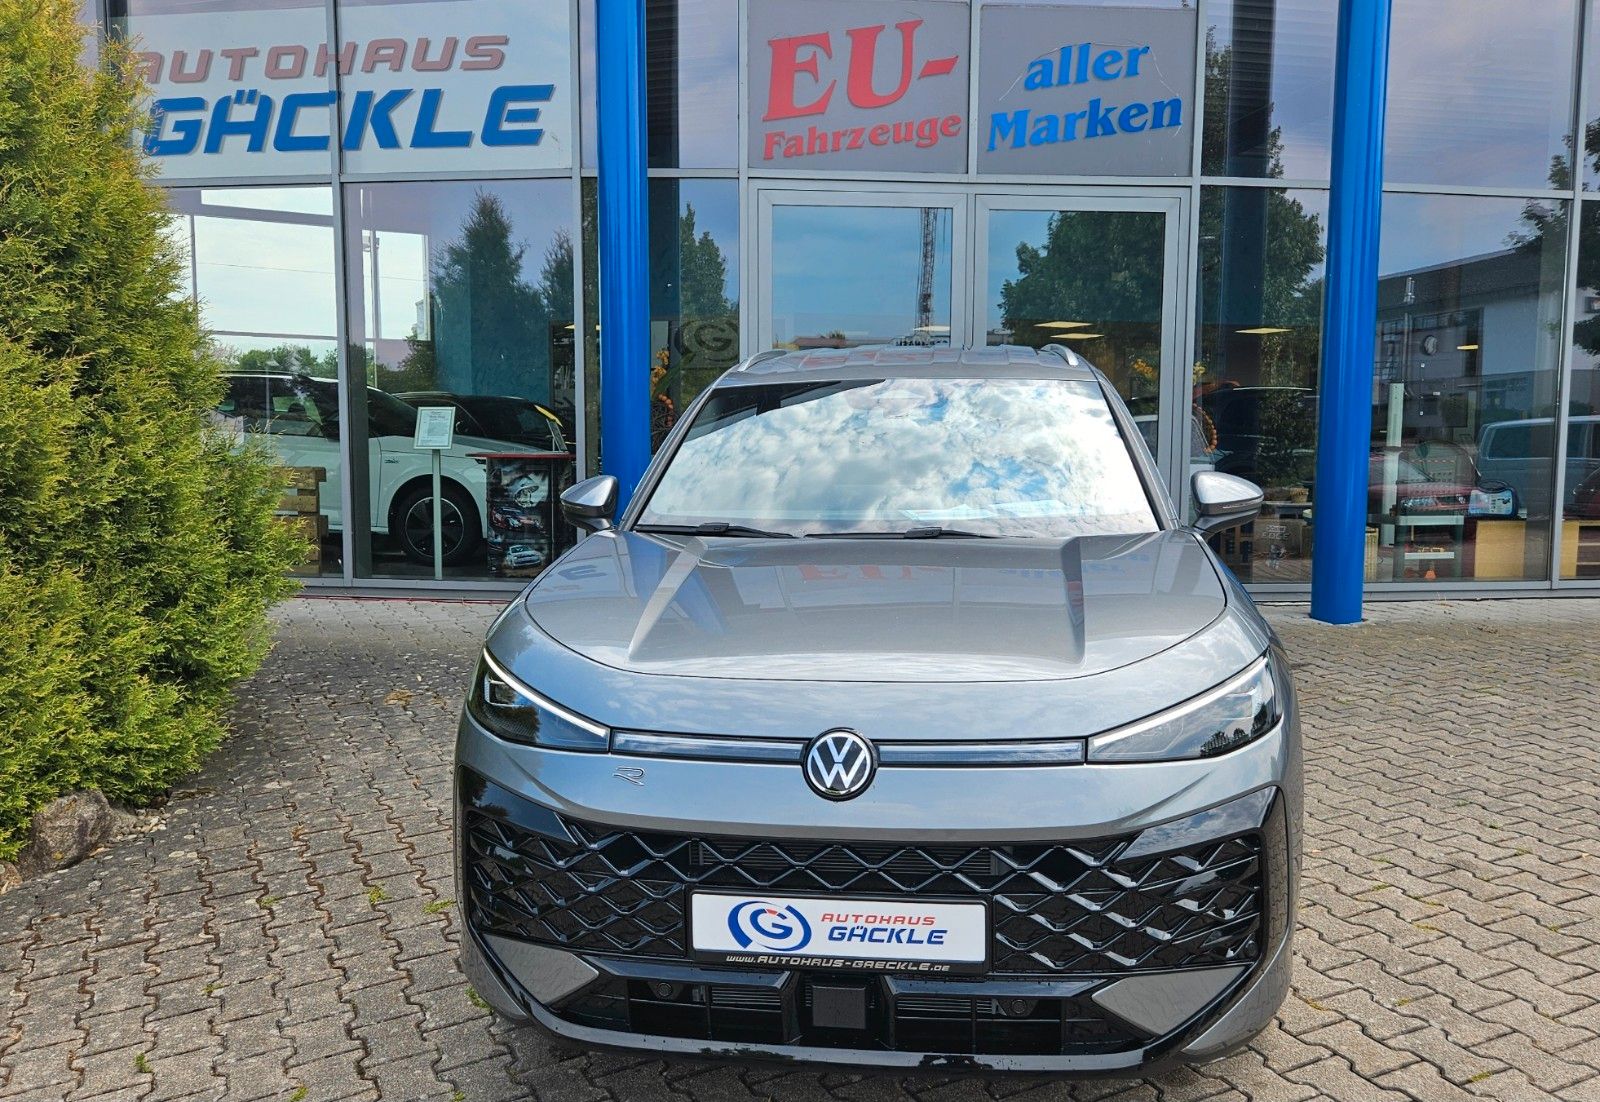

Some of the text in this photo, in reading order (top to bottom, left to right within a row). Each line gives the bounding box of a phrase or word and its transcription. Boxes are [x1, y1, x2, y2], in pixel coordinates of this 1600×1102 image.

[762, 19, 959, 122] EU-
[1024, 42, 1150, 91] aller
[144, 84, 554, 156] GÄCKLE
[763, 113, 962, 160] Fahrzeuge
[987, 97, 1182, 152] Marken
[821, 913, 936, 926] AUTOHAUS
[828, 925, 948, 945] GÄCKLE
